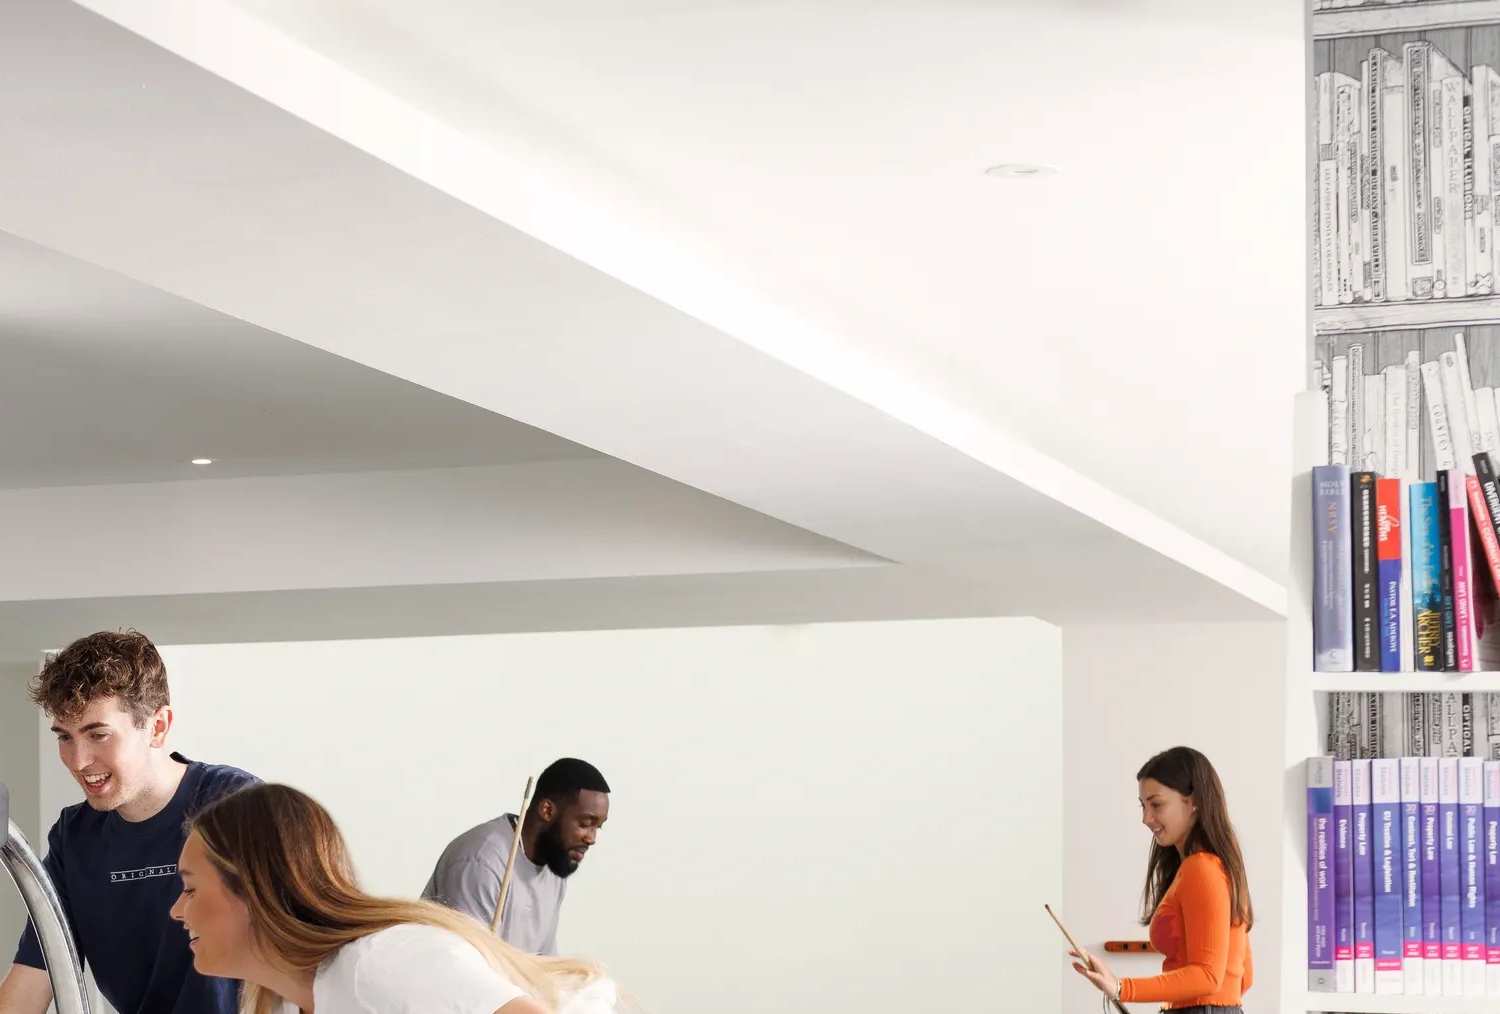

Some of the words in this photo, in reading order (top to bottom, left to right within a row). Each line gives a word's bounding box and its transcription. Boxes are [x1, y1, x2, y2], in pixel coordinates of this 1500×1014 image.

[1446, 82, 1460, 194] WALLPAPER
[1463, 105, 1471, 153] OPTICAL
[1463, 157, 1472, 220] ILLUSIONS
[1483, 480, 1500, 523] DIVERGENT
[1328, 501, 1338, 534] NRSV
[1378, 504, 1387, 542] HEAVENS
[1458, 580, 1466, 597] LAW
[1459, 598, 1467, 620] LAND
[1417, 607, 1432, 655] ARCHER
[1463, 705, 1471, 753] OPTICAL
[1319, 817, 1327, 830] the
[1357, 812, 1367, 841] Property
[1383, 811, 1392, 821] EU
[1467, 817, 1476, 839] Public
[1339, 818, 1348, 849] Evidence
[1383, 822, 1392, 848] Treaties
[1425, 817, 1435, 846] Property
[1446, 837, 1454, 850] Law
[1488, 821, 1497, 849] Property
[1318, 831, 1327, 860] realities
[1358, 842, 1367, 856] Law
[1408, 848, 1416, 862] Tort
[1426, 846, 1435, 860] Law
[1468, 840, 1476, 853] Law
[1489, 851, 1497, 865] Law
[1319, 861, 1327, 870] of
[1383, 857, 1393, 892] Legislation
[1408, 862, 1416, 870] &
[1468, 861, 1476, 885] Human
[1319, 870, 1328, 889] work
[1408, 870, 1417, 907] Restitution
[1467, 886, 1477, 908] Rights
